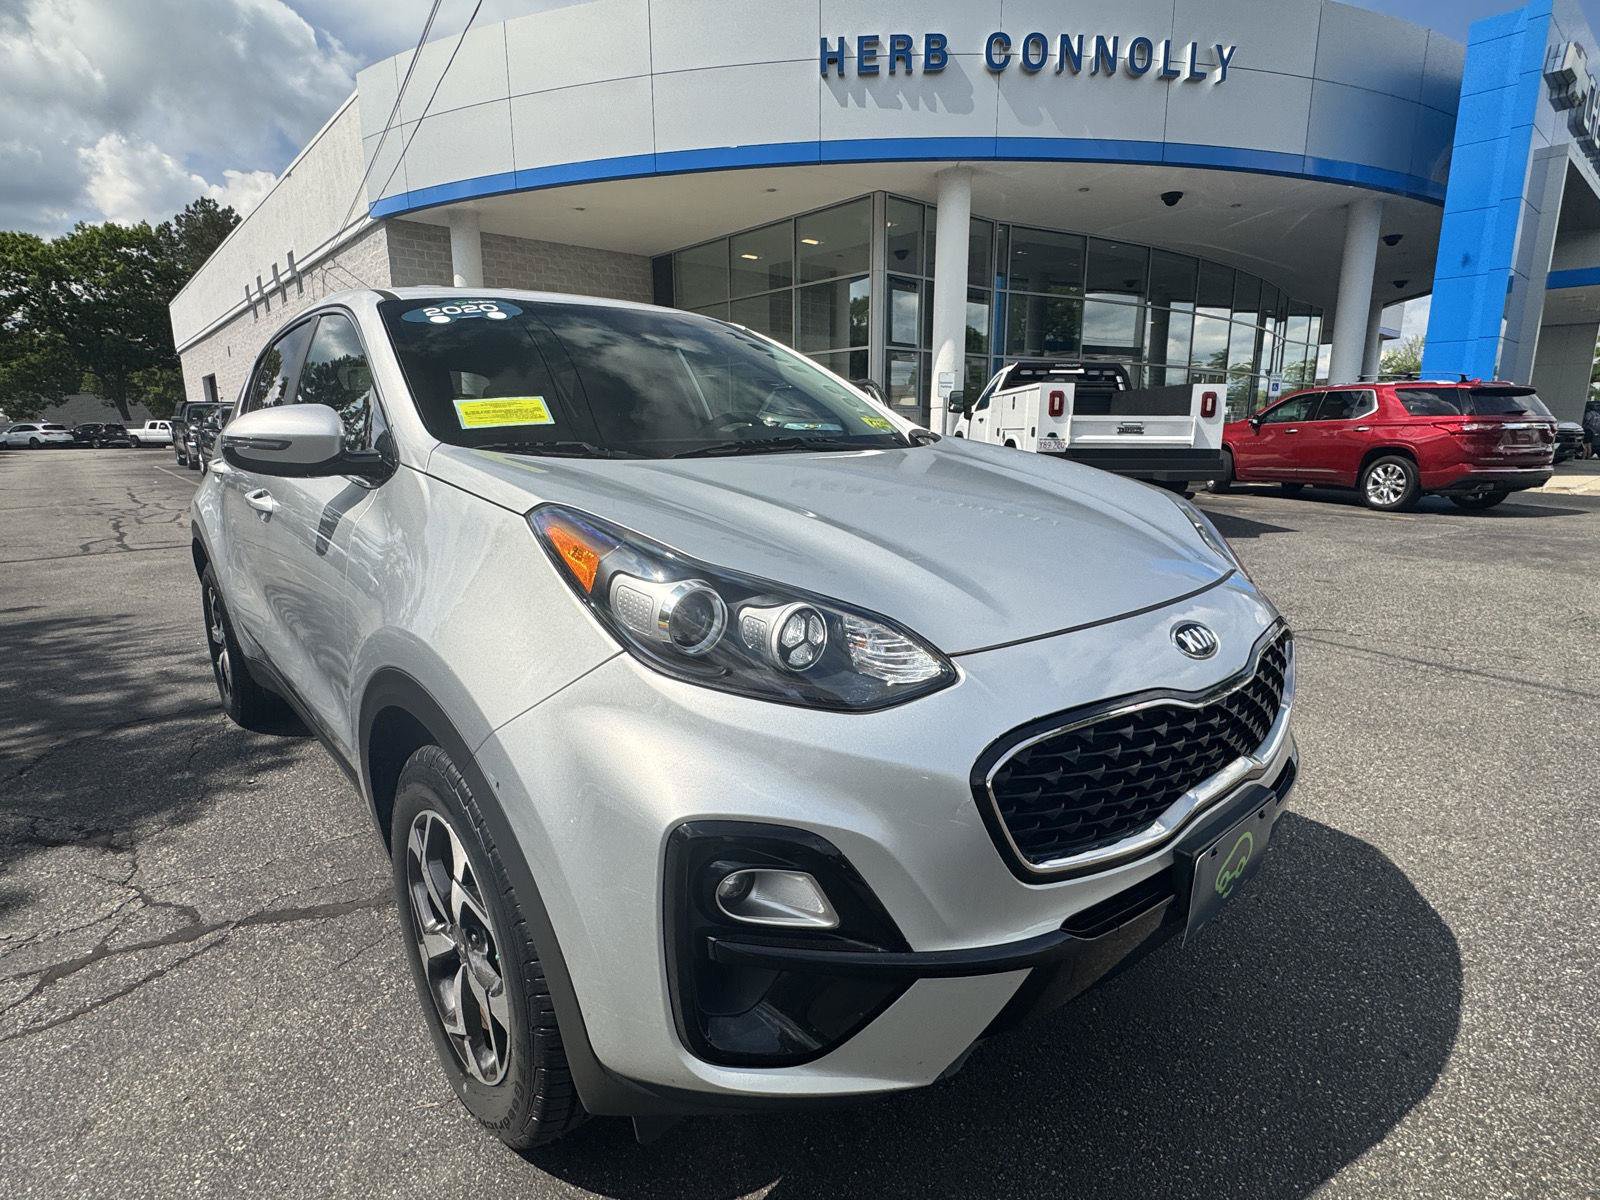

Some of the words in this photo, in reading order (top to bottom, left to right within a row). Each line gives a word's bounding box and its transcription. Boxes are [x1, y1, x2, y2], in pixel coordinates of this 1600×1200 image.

[820, 33, 949, 77] HERB
[985, 31, 1237, 85] CONNOLLY
[423, 304, 499, 317] 2020
[1177, 626, 1216, 653] KIA
